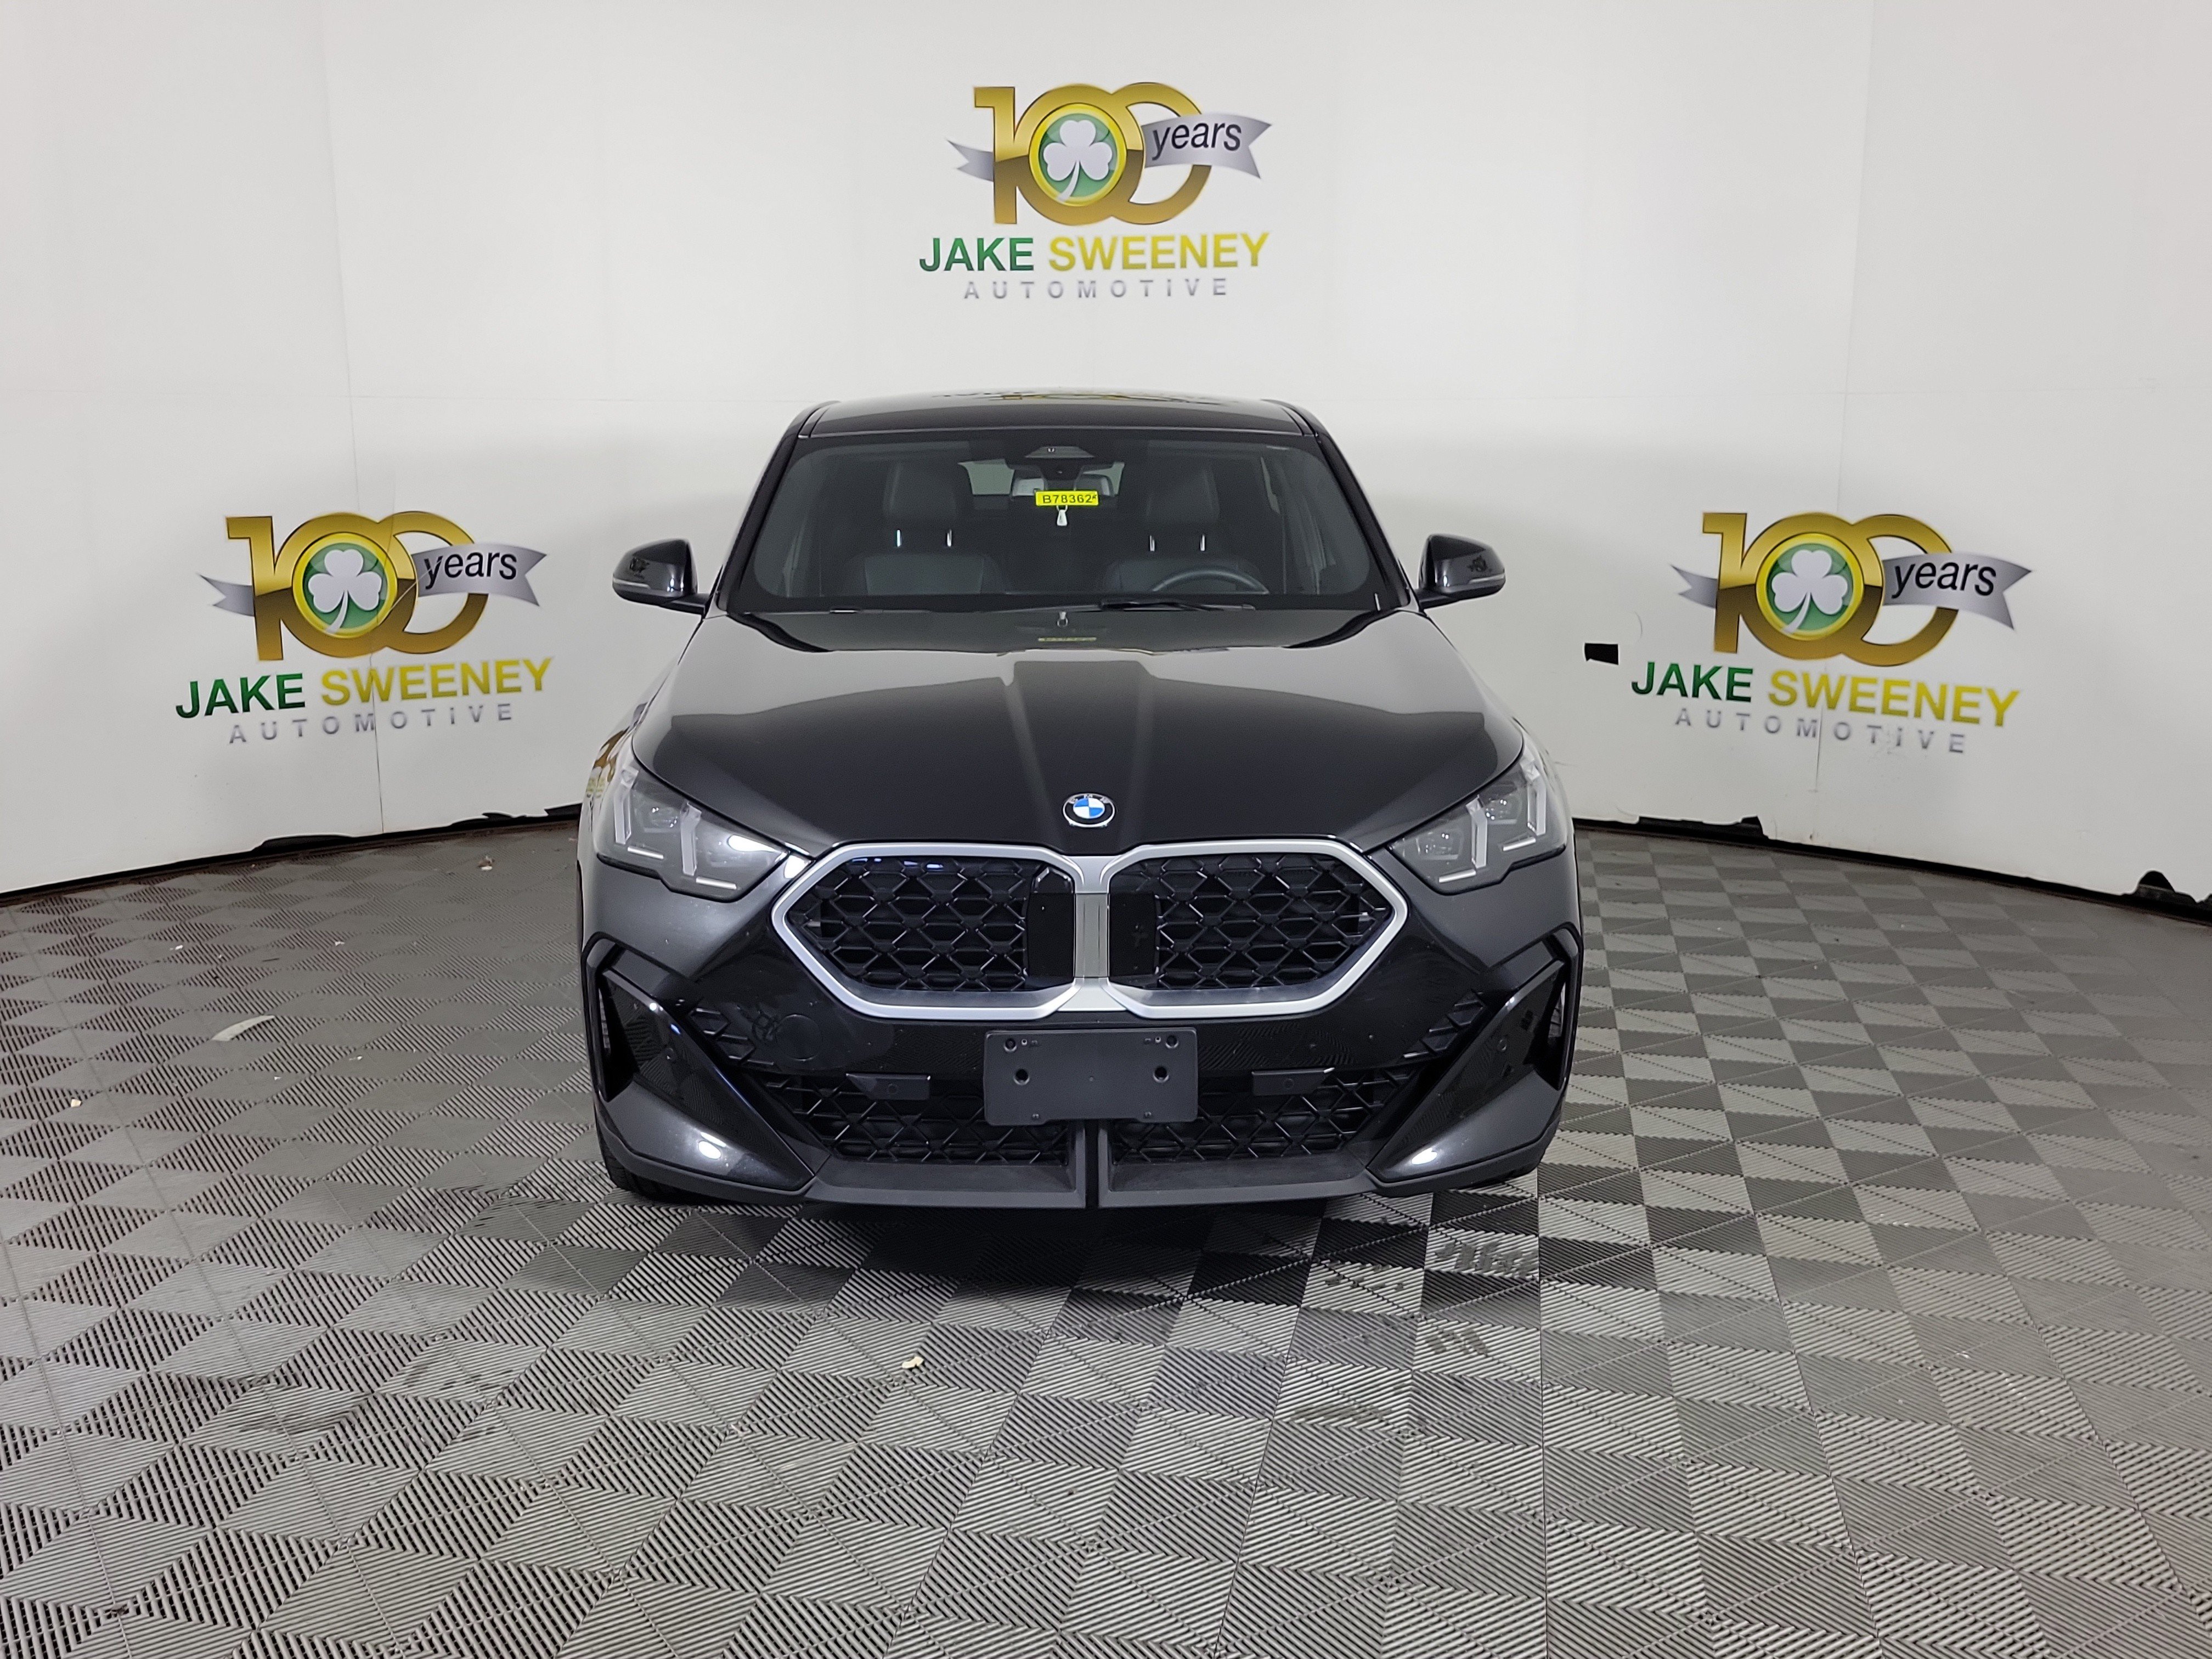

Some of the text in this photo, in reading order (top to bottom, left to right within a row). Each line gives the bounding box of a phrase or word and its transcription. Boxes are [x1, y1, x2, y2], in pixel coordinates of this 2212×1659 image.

[973, 82, 1242, 225] 100 years
[919, 233, 1269, 272] JAKE SWEENEY
[963, 278, 1227, 300] AUTOMOTIVE
[225, 511, 517, 661] 100 years
[1702, 512, 1997, 667] 100 years
[176, 657, 553, 719] JAKE SWEENEY
[1632, 661, 2020, 727] JAKE SWEENEY
[229, 703, 512, 744] AUTOMOTIVE
[1675, 708, 1966, 753] AUTOMOTIVE
